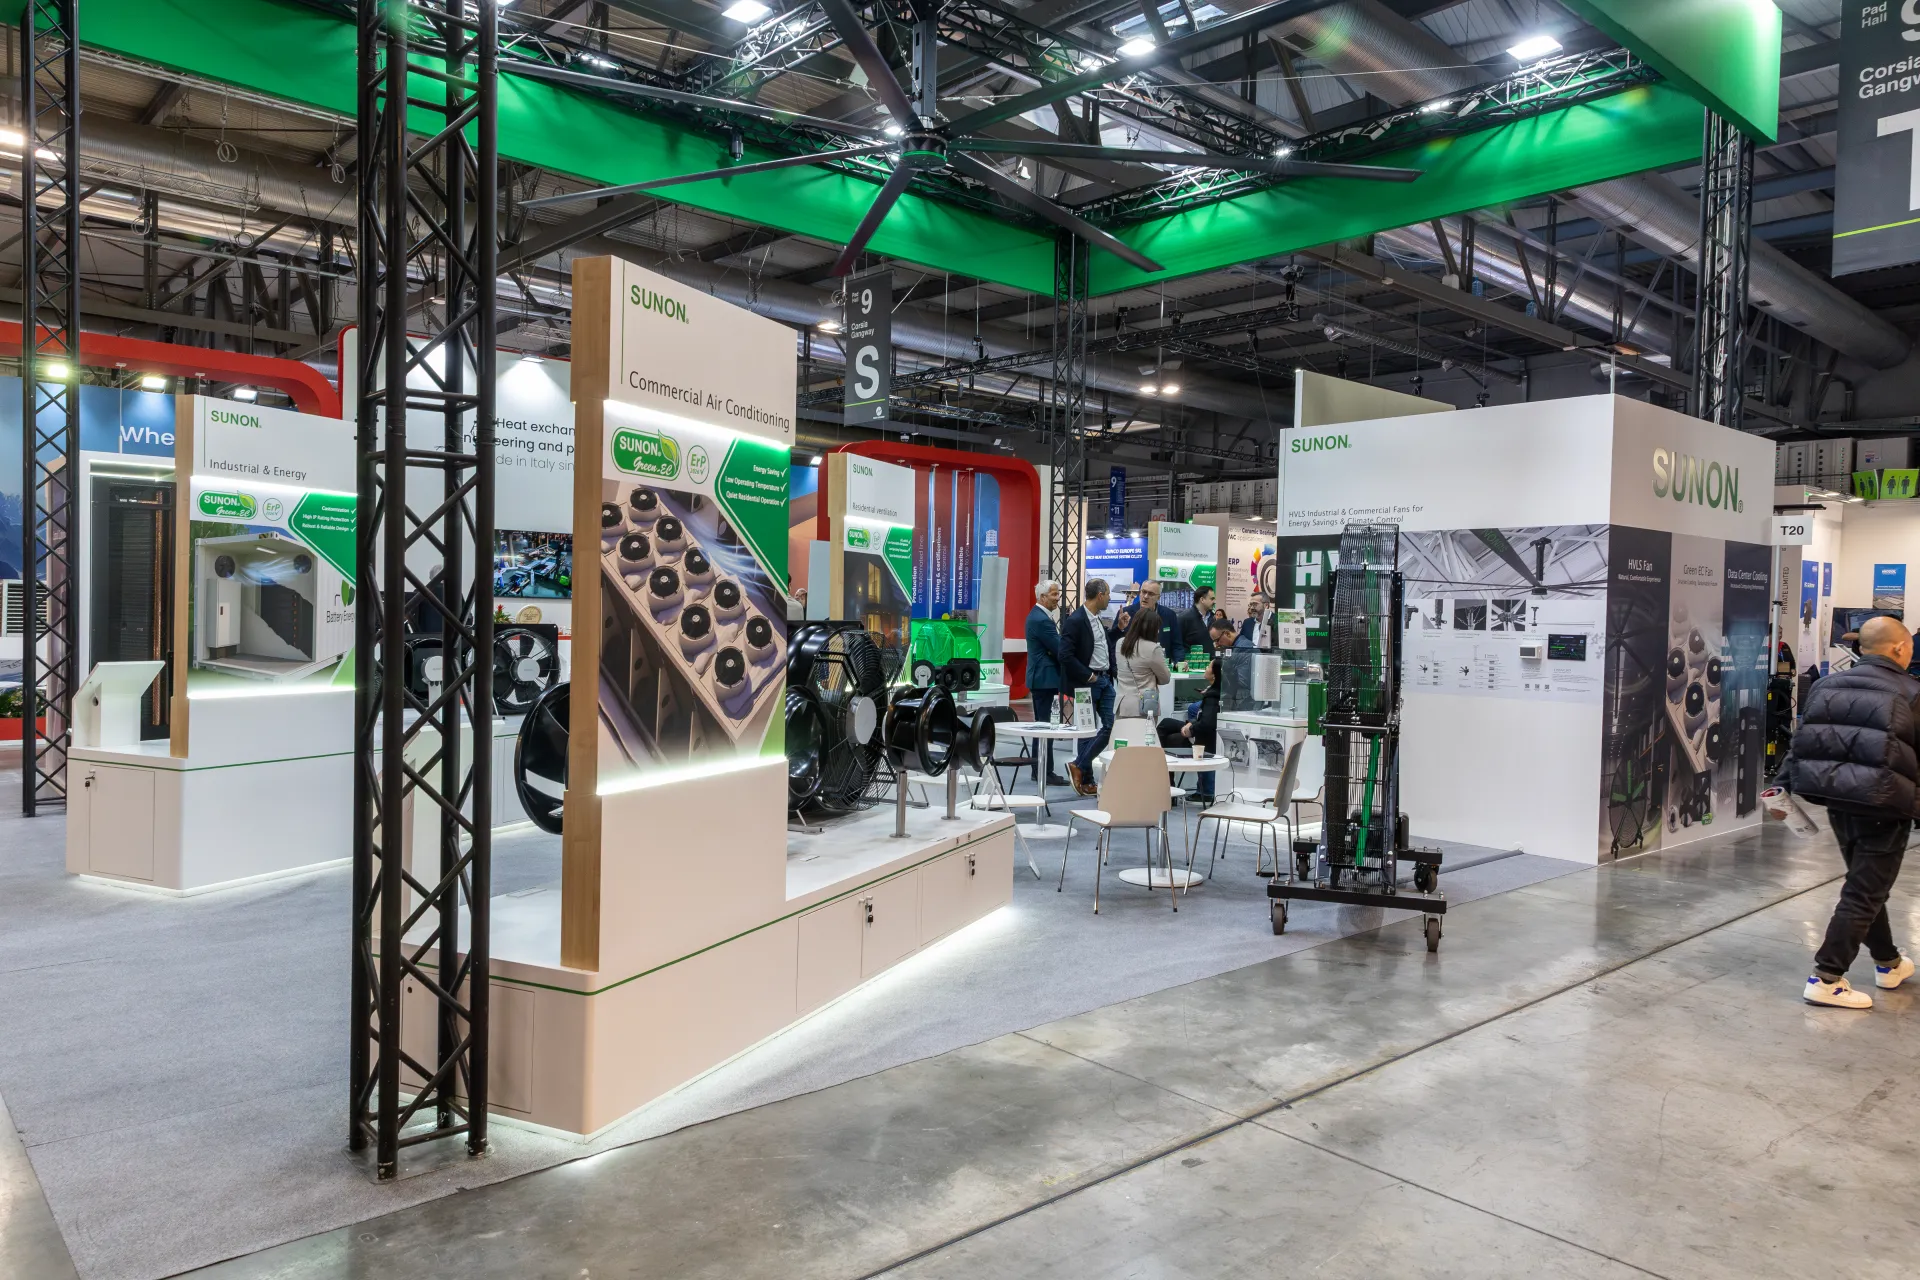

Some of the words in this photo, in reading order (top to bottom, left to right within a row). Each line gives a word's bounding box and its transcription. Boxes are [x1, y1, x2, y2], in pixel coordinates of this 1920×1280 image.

[1862, 1, 1887, 18] Pad
[1861, 12, 1887, 28] Hall
[862, 288, 872, 314] 9
[851, 320, 868, 330] Corsia
[851, 328, 874, 338] Gangway
[854, 345, 880, 399] S
[630, 370, 702, 406] Commercial
[706, 393, 722, 412] Air
[726, 398, 790, 433] Conditioning
[496, 418, 527, 430] Heat
[538, 442, 563, 452] and
[516, 455, 526, 466] in
[530, 456, 556, 472] Italy
[690, 454, 706, 468] ErP
[210, 459, 260, 474] Industrial
[264, 465, 270, 476] &
[274, 467, 307, 480] Energy
[754, 464, 766, 474] Energy
[767, 468, 779, 477] Saving
[852, 464, 873, 476] SUNON
[735, 477, 754, 488] Operating
[755, 481, 779, 491] Temperature
[1110, 476, 1117, 488] 9
[726, 490, 737, 499] Quiet
[739, 493, 760, 502] Residential
[761, 497, 779, 505] Operation
[266, 503, 280, 512] ErP
[852, 502, 875, 513] Residential
[876, 508, 897, 517] ventilation
[1349, 506, 1390, 515] Commercial
[1376, 515, 1403, 523] Control
[1780, 525, 1804, 536] T20
[1628, 559, 1642, 570] HVLS
[1643, 560, 1652, 571] Fan
[1684, 564, 1697, 575] Green
[1698, 565, 1704, 576] EC
[1705, 566, 1713, 576] Fan
[958, 572, 963, 580] be
[1728, 569, 1737, 578] Data
[1738, 570, 1752, 579] Center
[1753, 571, 1768, 583] Cooling
[327, 610, 343, 624] Battery
